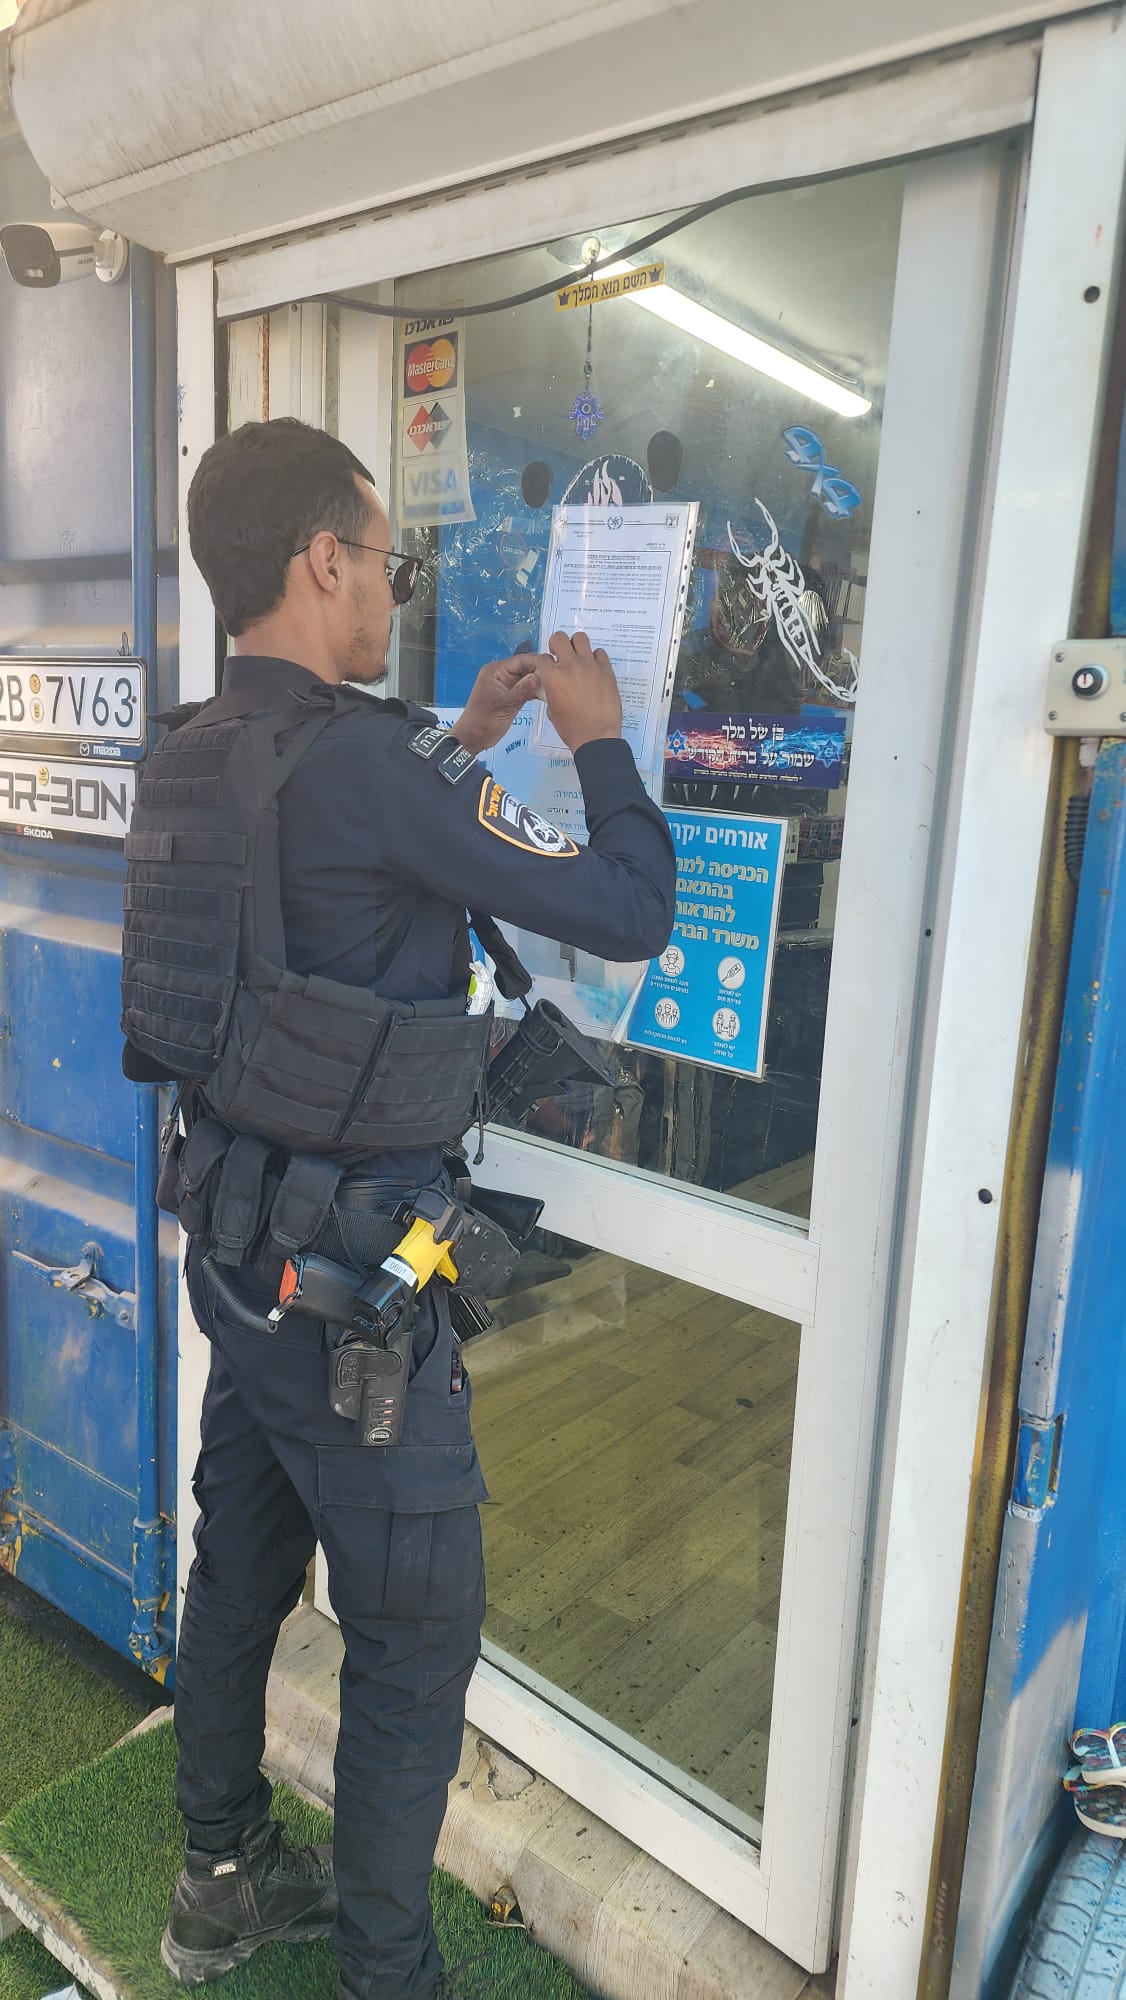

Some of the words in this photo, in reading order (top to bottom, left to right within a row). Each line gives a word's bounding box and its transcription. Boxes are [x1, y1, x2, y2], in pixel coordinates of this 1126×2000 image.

[601, 279, 620, 297] הוא
[623, 272, 647, 290] השם
[572, 283, 599, 307] המלך
[407, 356, 454, 378] MasterCard
[407, 468, 458, 497] VISA
[46, 675, 134, 728] 7V63
[721, 716, 746, 747] מלך
[749, 717, 768, 741] של
[772, 723, 785, 747] בן
[93, 745, 121, 756] mazda
[688, 746, 725, 769] הקודש
[728, 749, 757, 765] ברית
[761, 744, 778, 767] על
[781, 751, 815, 768] שמור
[24, 825, 54, 840] ŠKODA
[705, 826, 768, 850] אורחים
[708, 861, 769, 884] הכניסה
[675, 878, 734, 900] בהתאם
[712, 928, 759, 951] משרד
